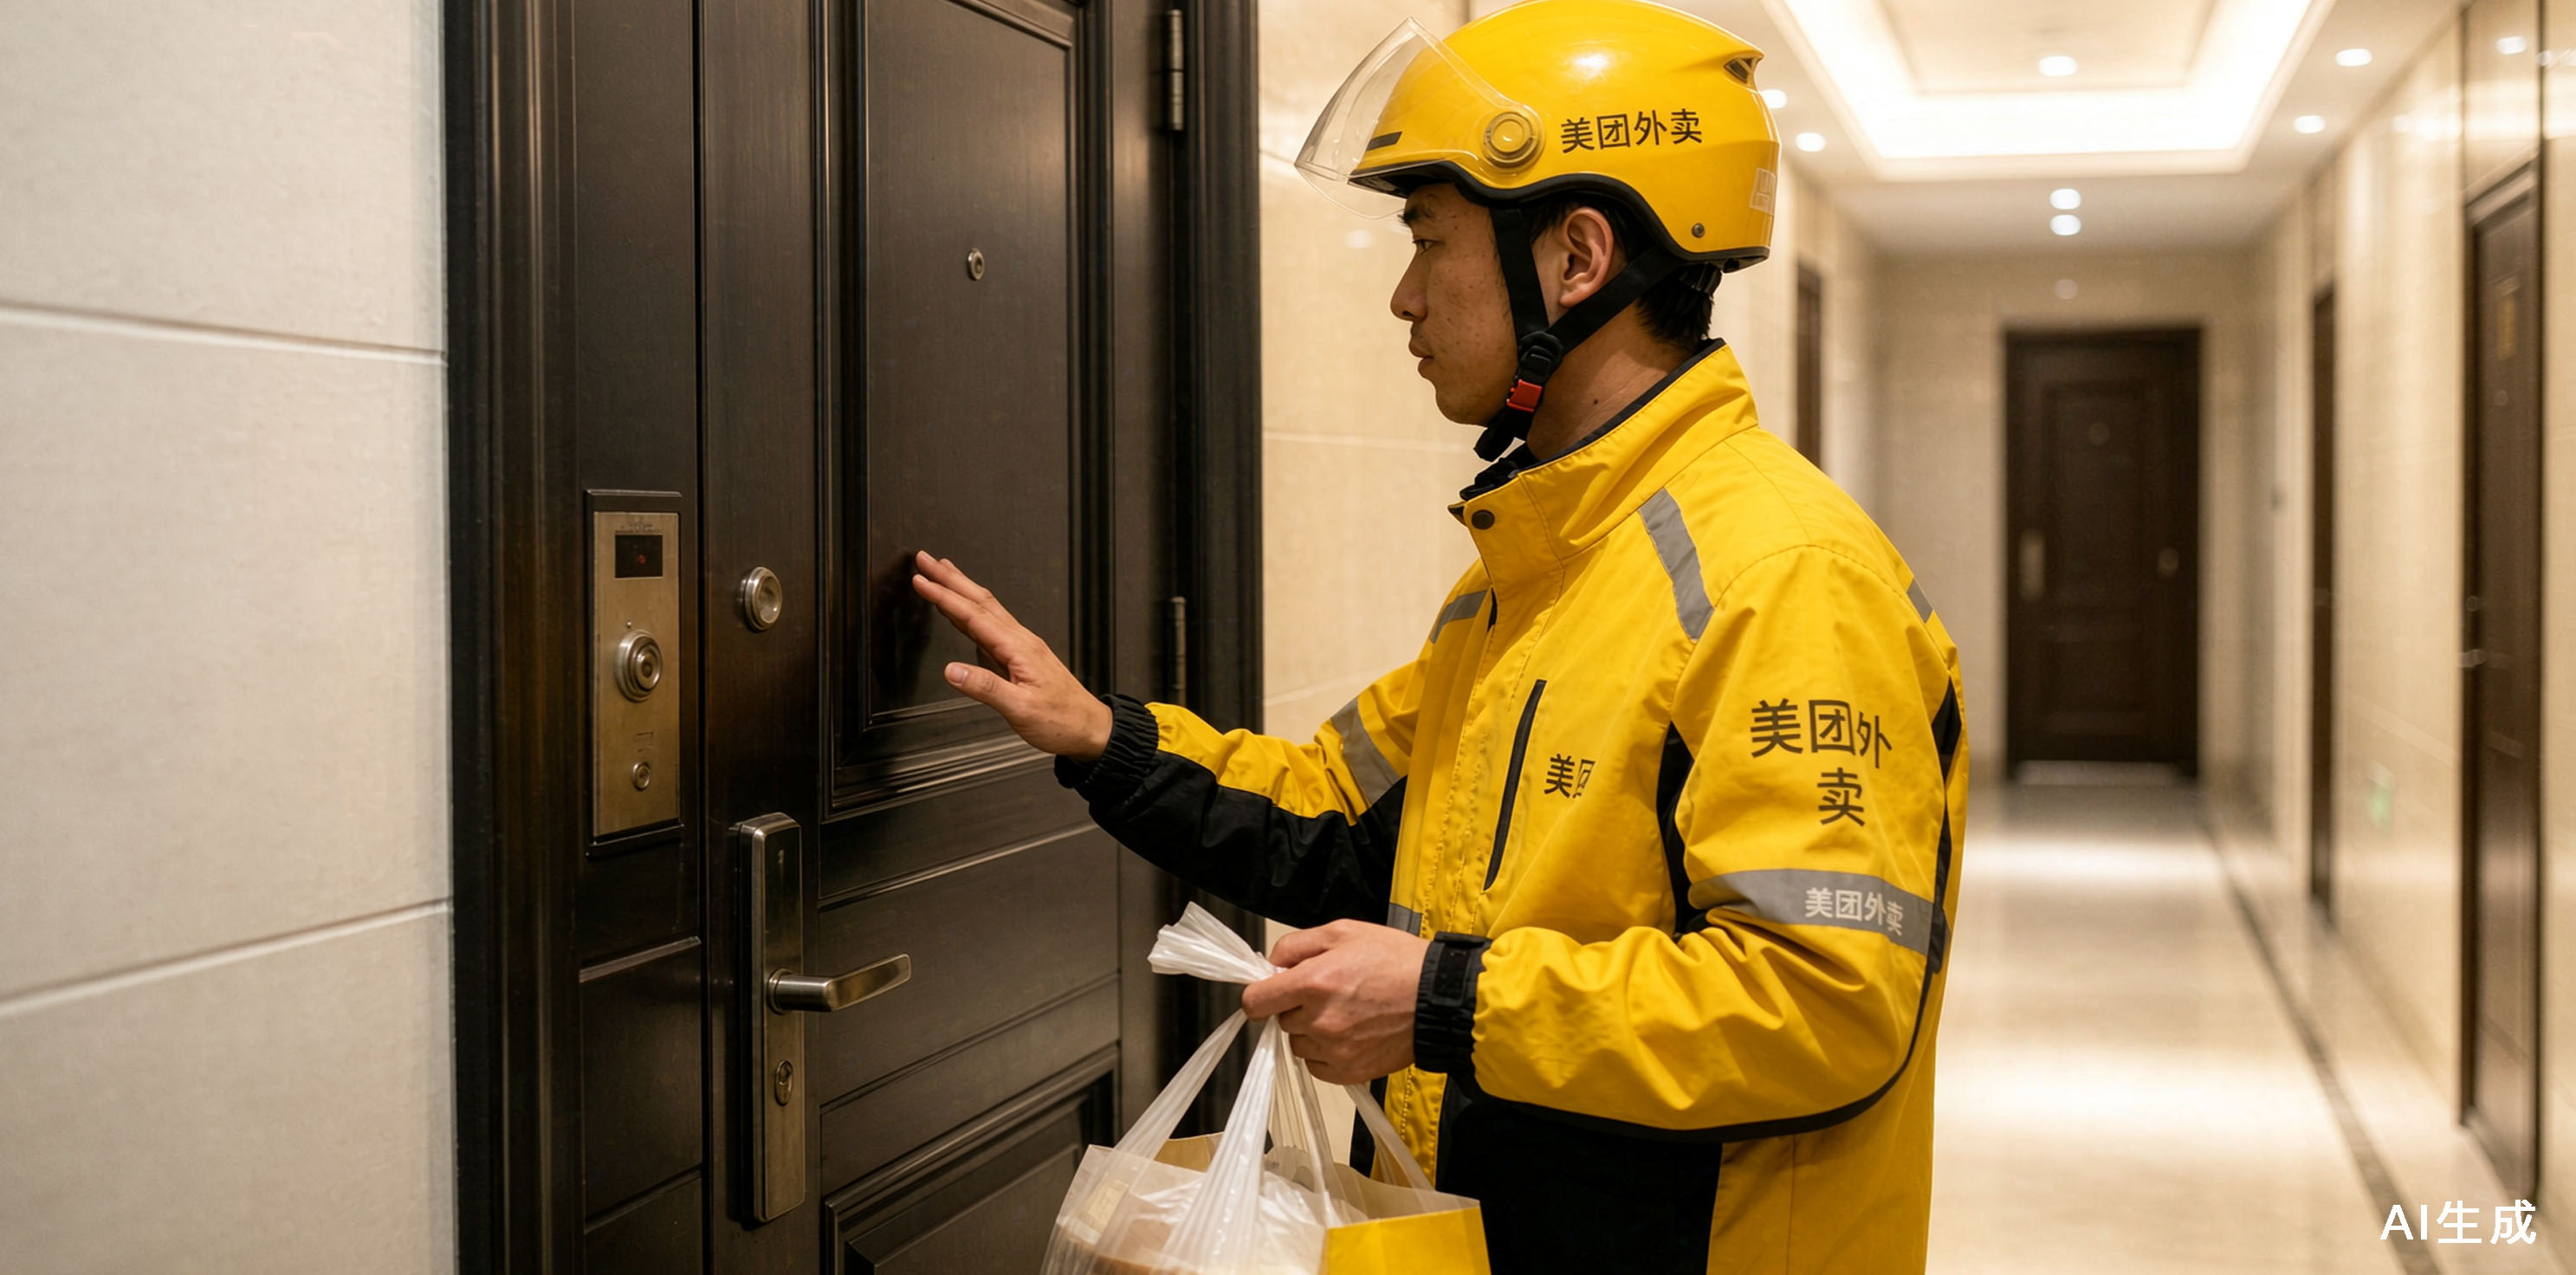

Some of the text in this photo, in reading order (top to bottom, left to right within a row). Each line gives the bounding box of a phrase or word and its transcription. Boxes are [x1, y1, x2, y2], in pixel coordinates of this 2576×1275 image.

[1560, 107, 1703, 154] 美团外卖
[1750, 697, 1893, 769] 美团外
[1816, 767, 1866, 827] 卖
[1804, 886, 1904, 936] 美团外卖
